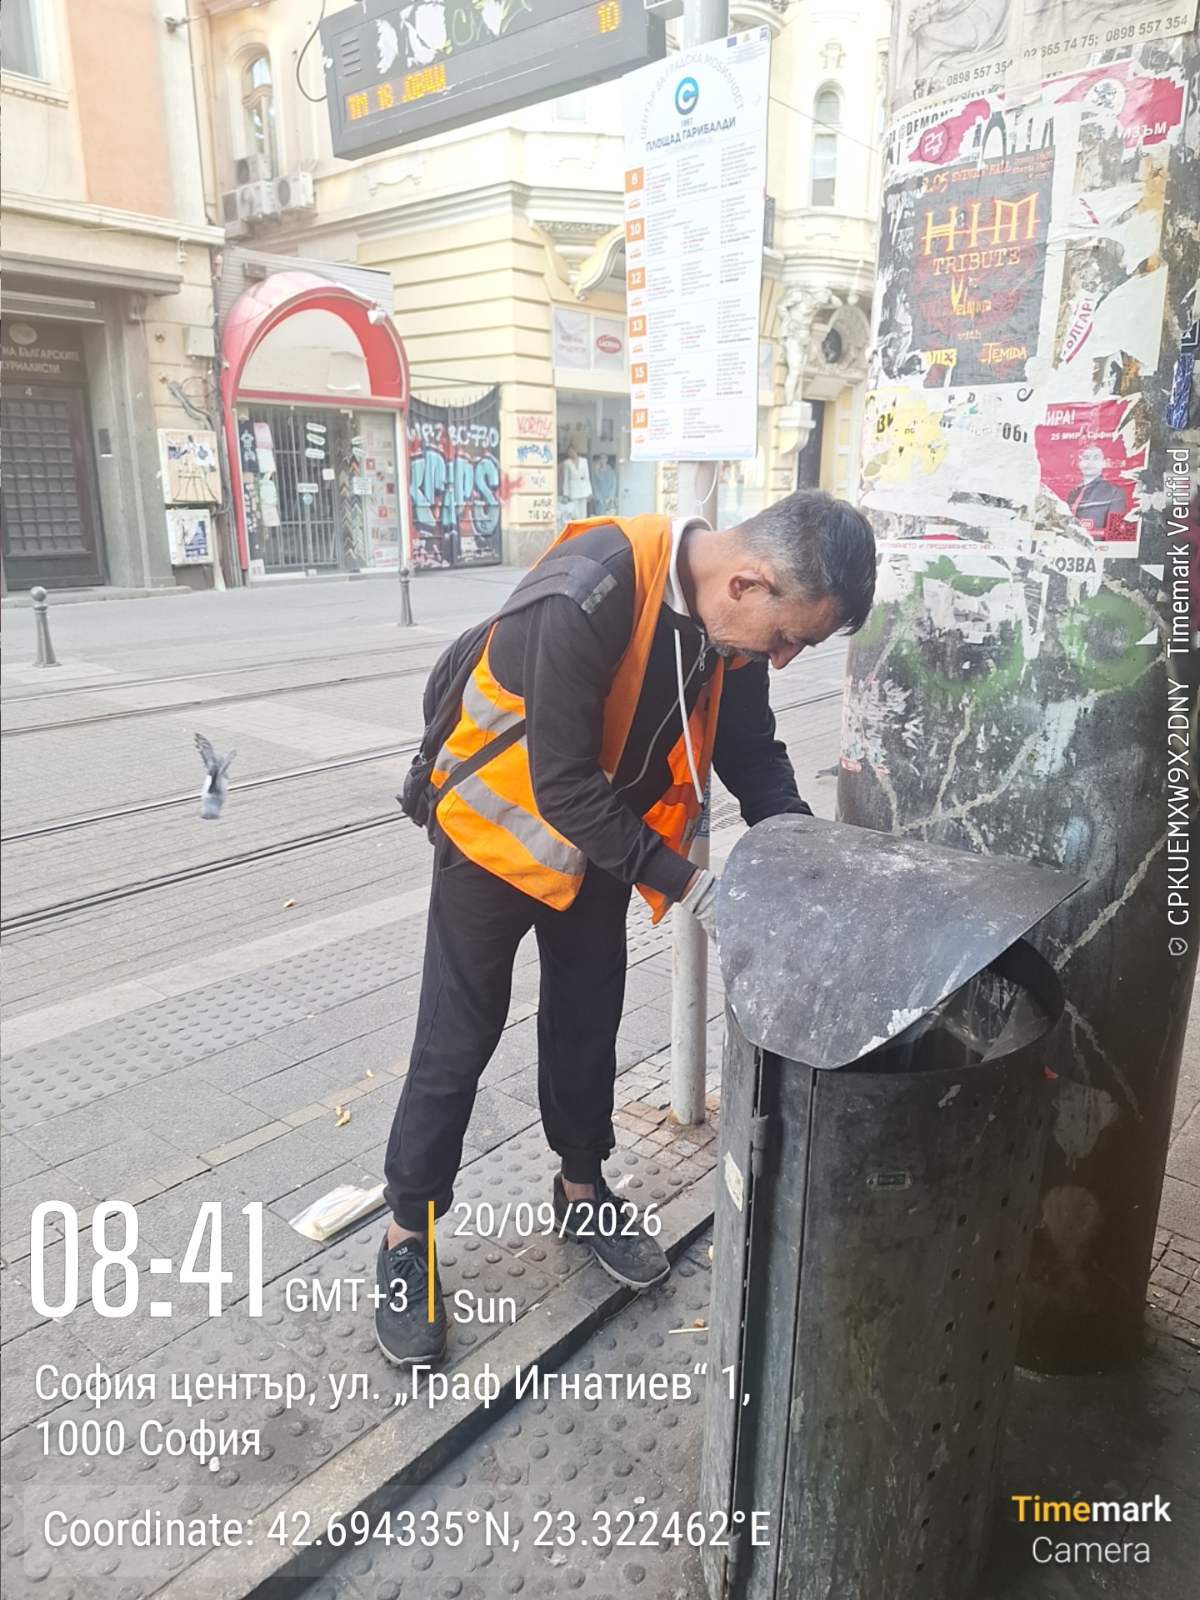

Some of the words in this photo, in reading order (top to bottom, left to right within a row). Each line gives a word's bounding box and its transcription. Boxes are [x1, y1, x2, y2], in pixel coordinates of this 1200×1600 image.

[1063, 35, 1078, 51] 74
[1080, 32, 1100, 49] 75;
[1105, 23, 1136, 44] 0898
[1138, 17, 1163, 37] 557
[1164, 13, 1189, 32] 354
[946, 70, 972, 88] 0898
[973, 64, 993, 81] 557
[646, 132, 682, 153] ПЛОЩАД
[682, 116, 737, 141] ГАРИБАЛДИ
[921, 191, 1041, 256] HIM
[932, 246, 1021, 276] TRIBUTE
